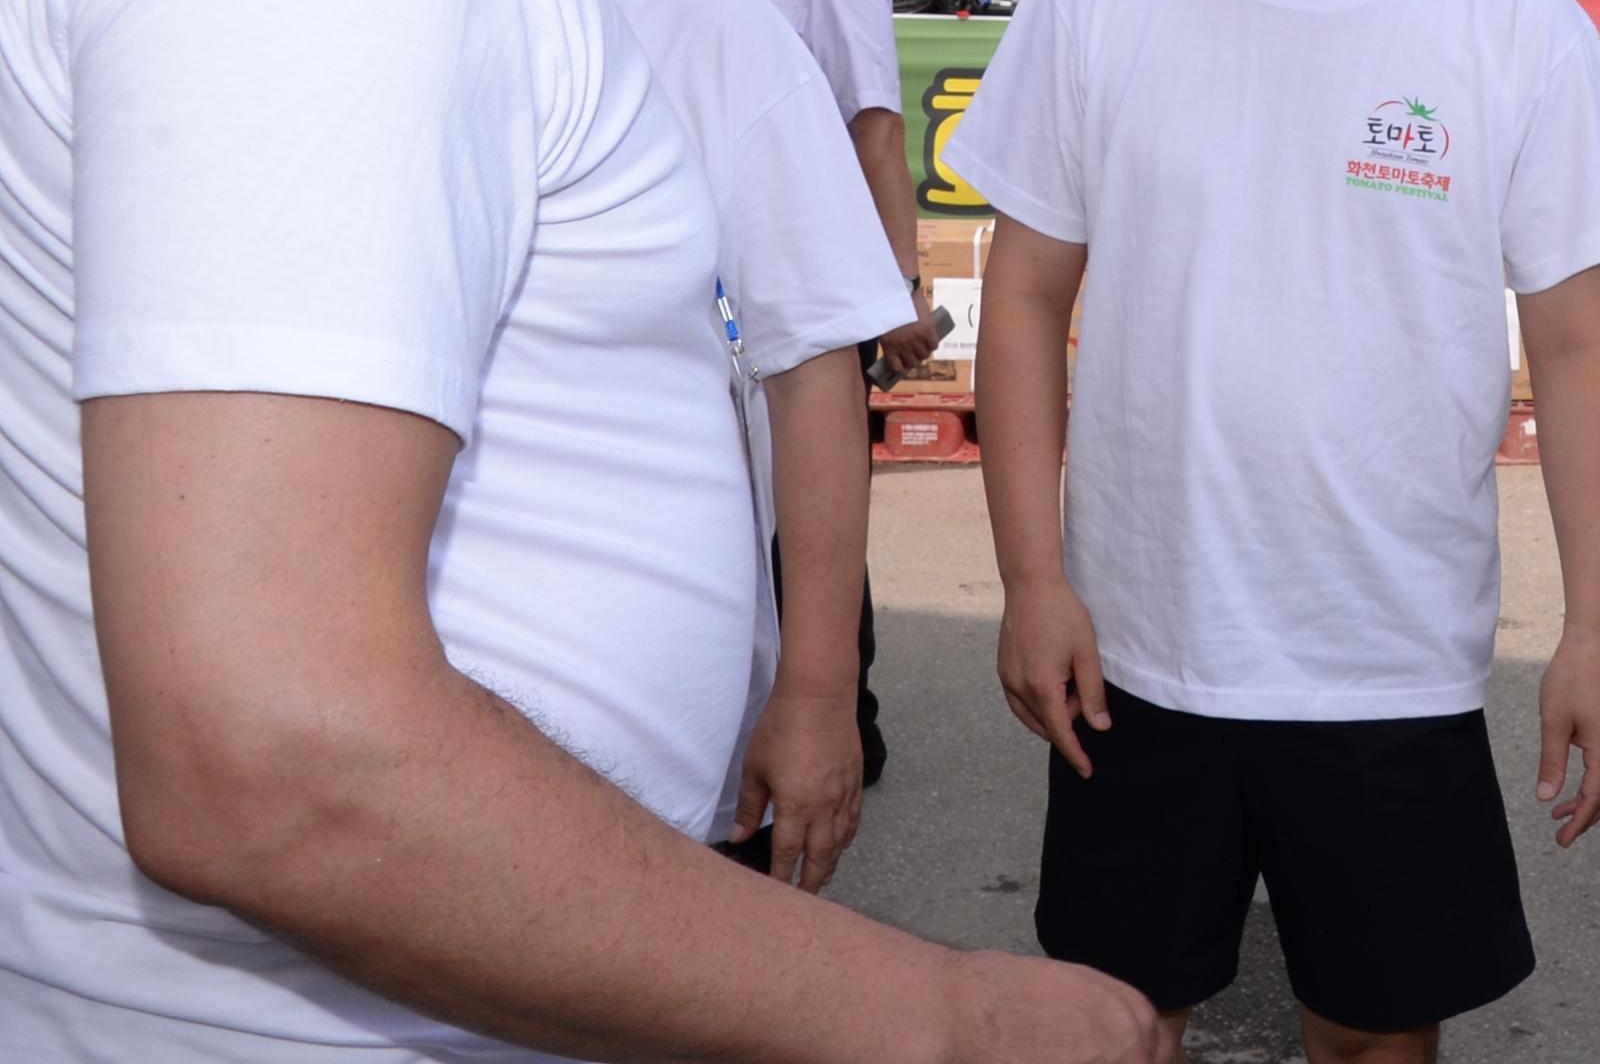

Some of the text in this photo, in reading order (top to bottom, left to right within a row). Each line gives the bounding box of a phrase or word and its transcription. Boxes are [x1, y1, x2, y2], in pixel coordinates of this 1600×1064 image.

[1361, 117, 1437, 153] 토마토
[1346, 160, 1451, 192] 화천토마토축제
[1346, 176, 1449, 202] TOMATO FESTIVAL
